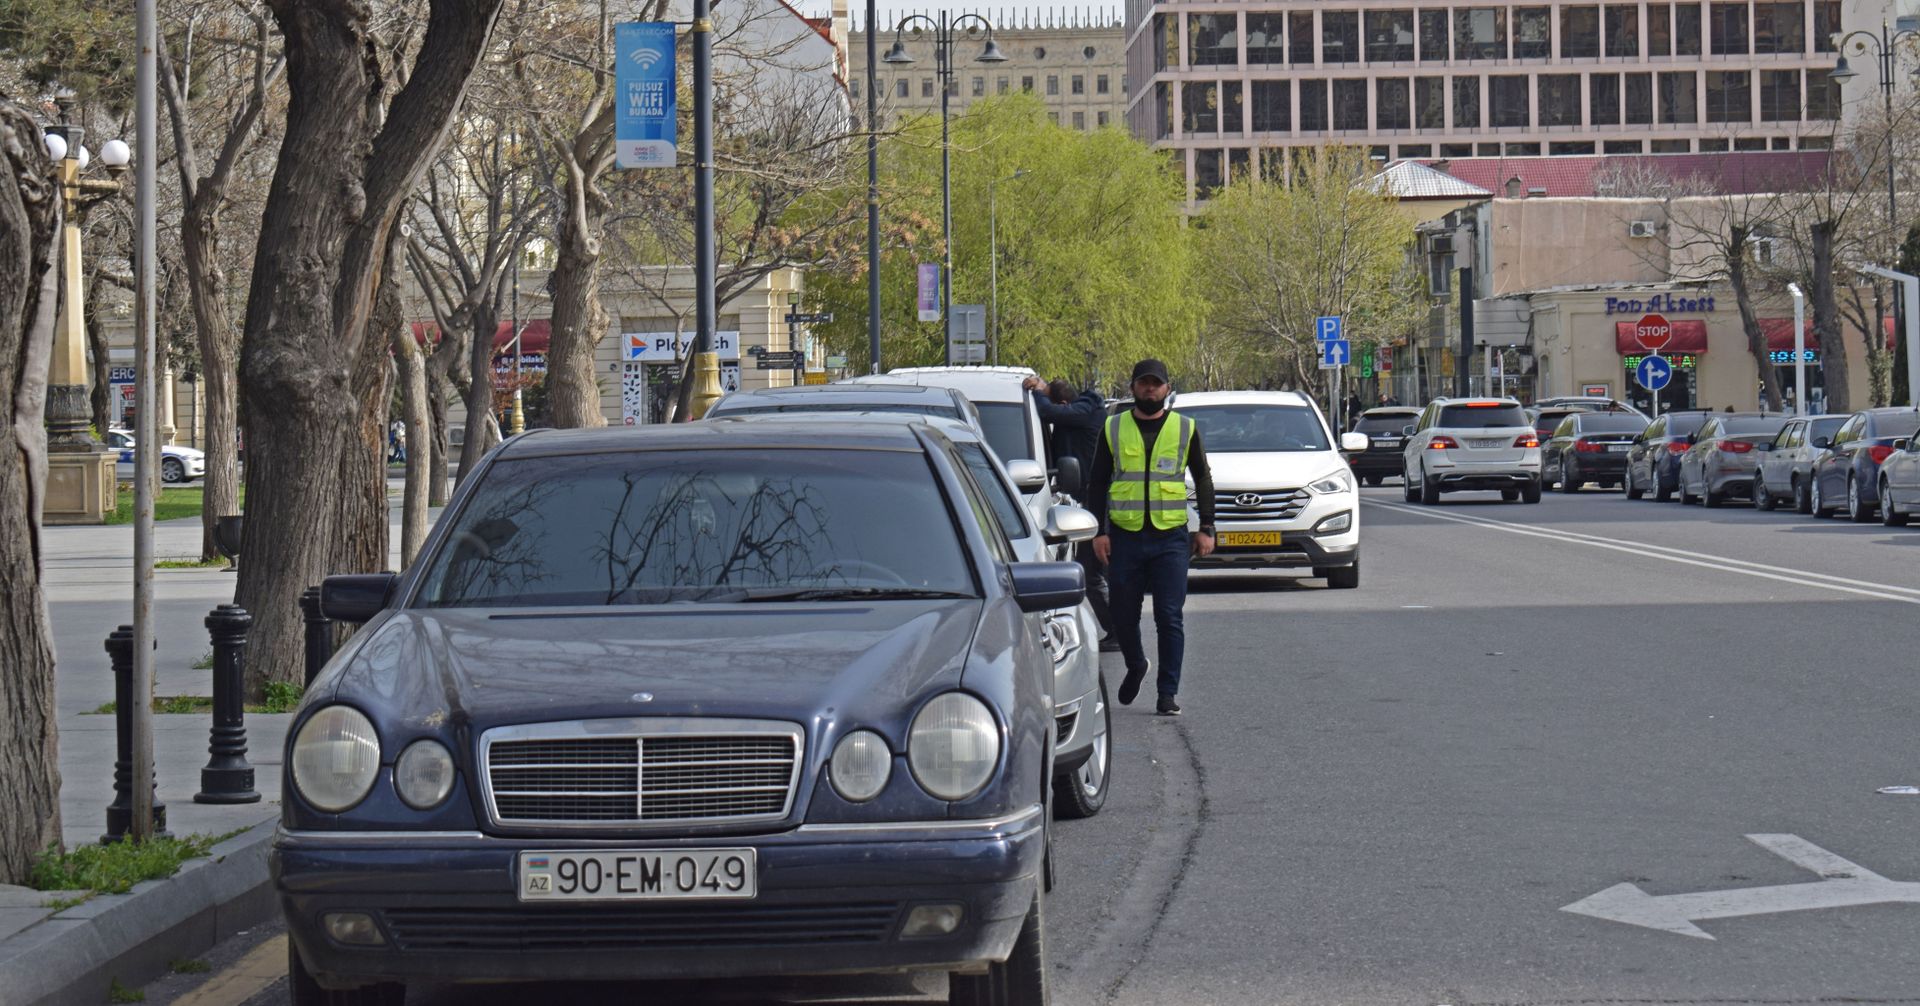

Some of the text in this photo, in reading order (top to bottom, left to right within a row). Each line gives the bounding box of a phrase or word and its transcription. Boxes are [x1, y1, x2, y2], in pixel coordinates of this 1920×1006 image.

[629, 82, 663, 92] PULSUZ
[629, 93, 663, 107] WiFi
[629, 107, 663, 117] BURADA
[1605, 292, 1714, 315] Fon Aksess
[1323, 319, 1337, 338] P
[1638, 326, 1668, 336] STOP
[656, 336, 729, 353] Playh
[557, 856, 745, 894] 90-EM-049
[529, 877, 548, 890] AZ
